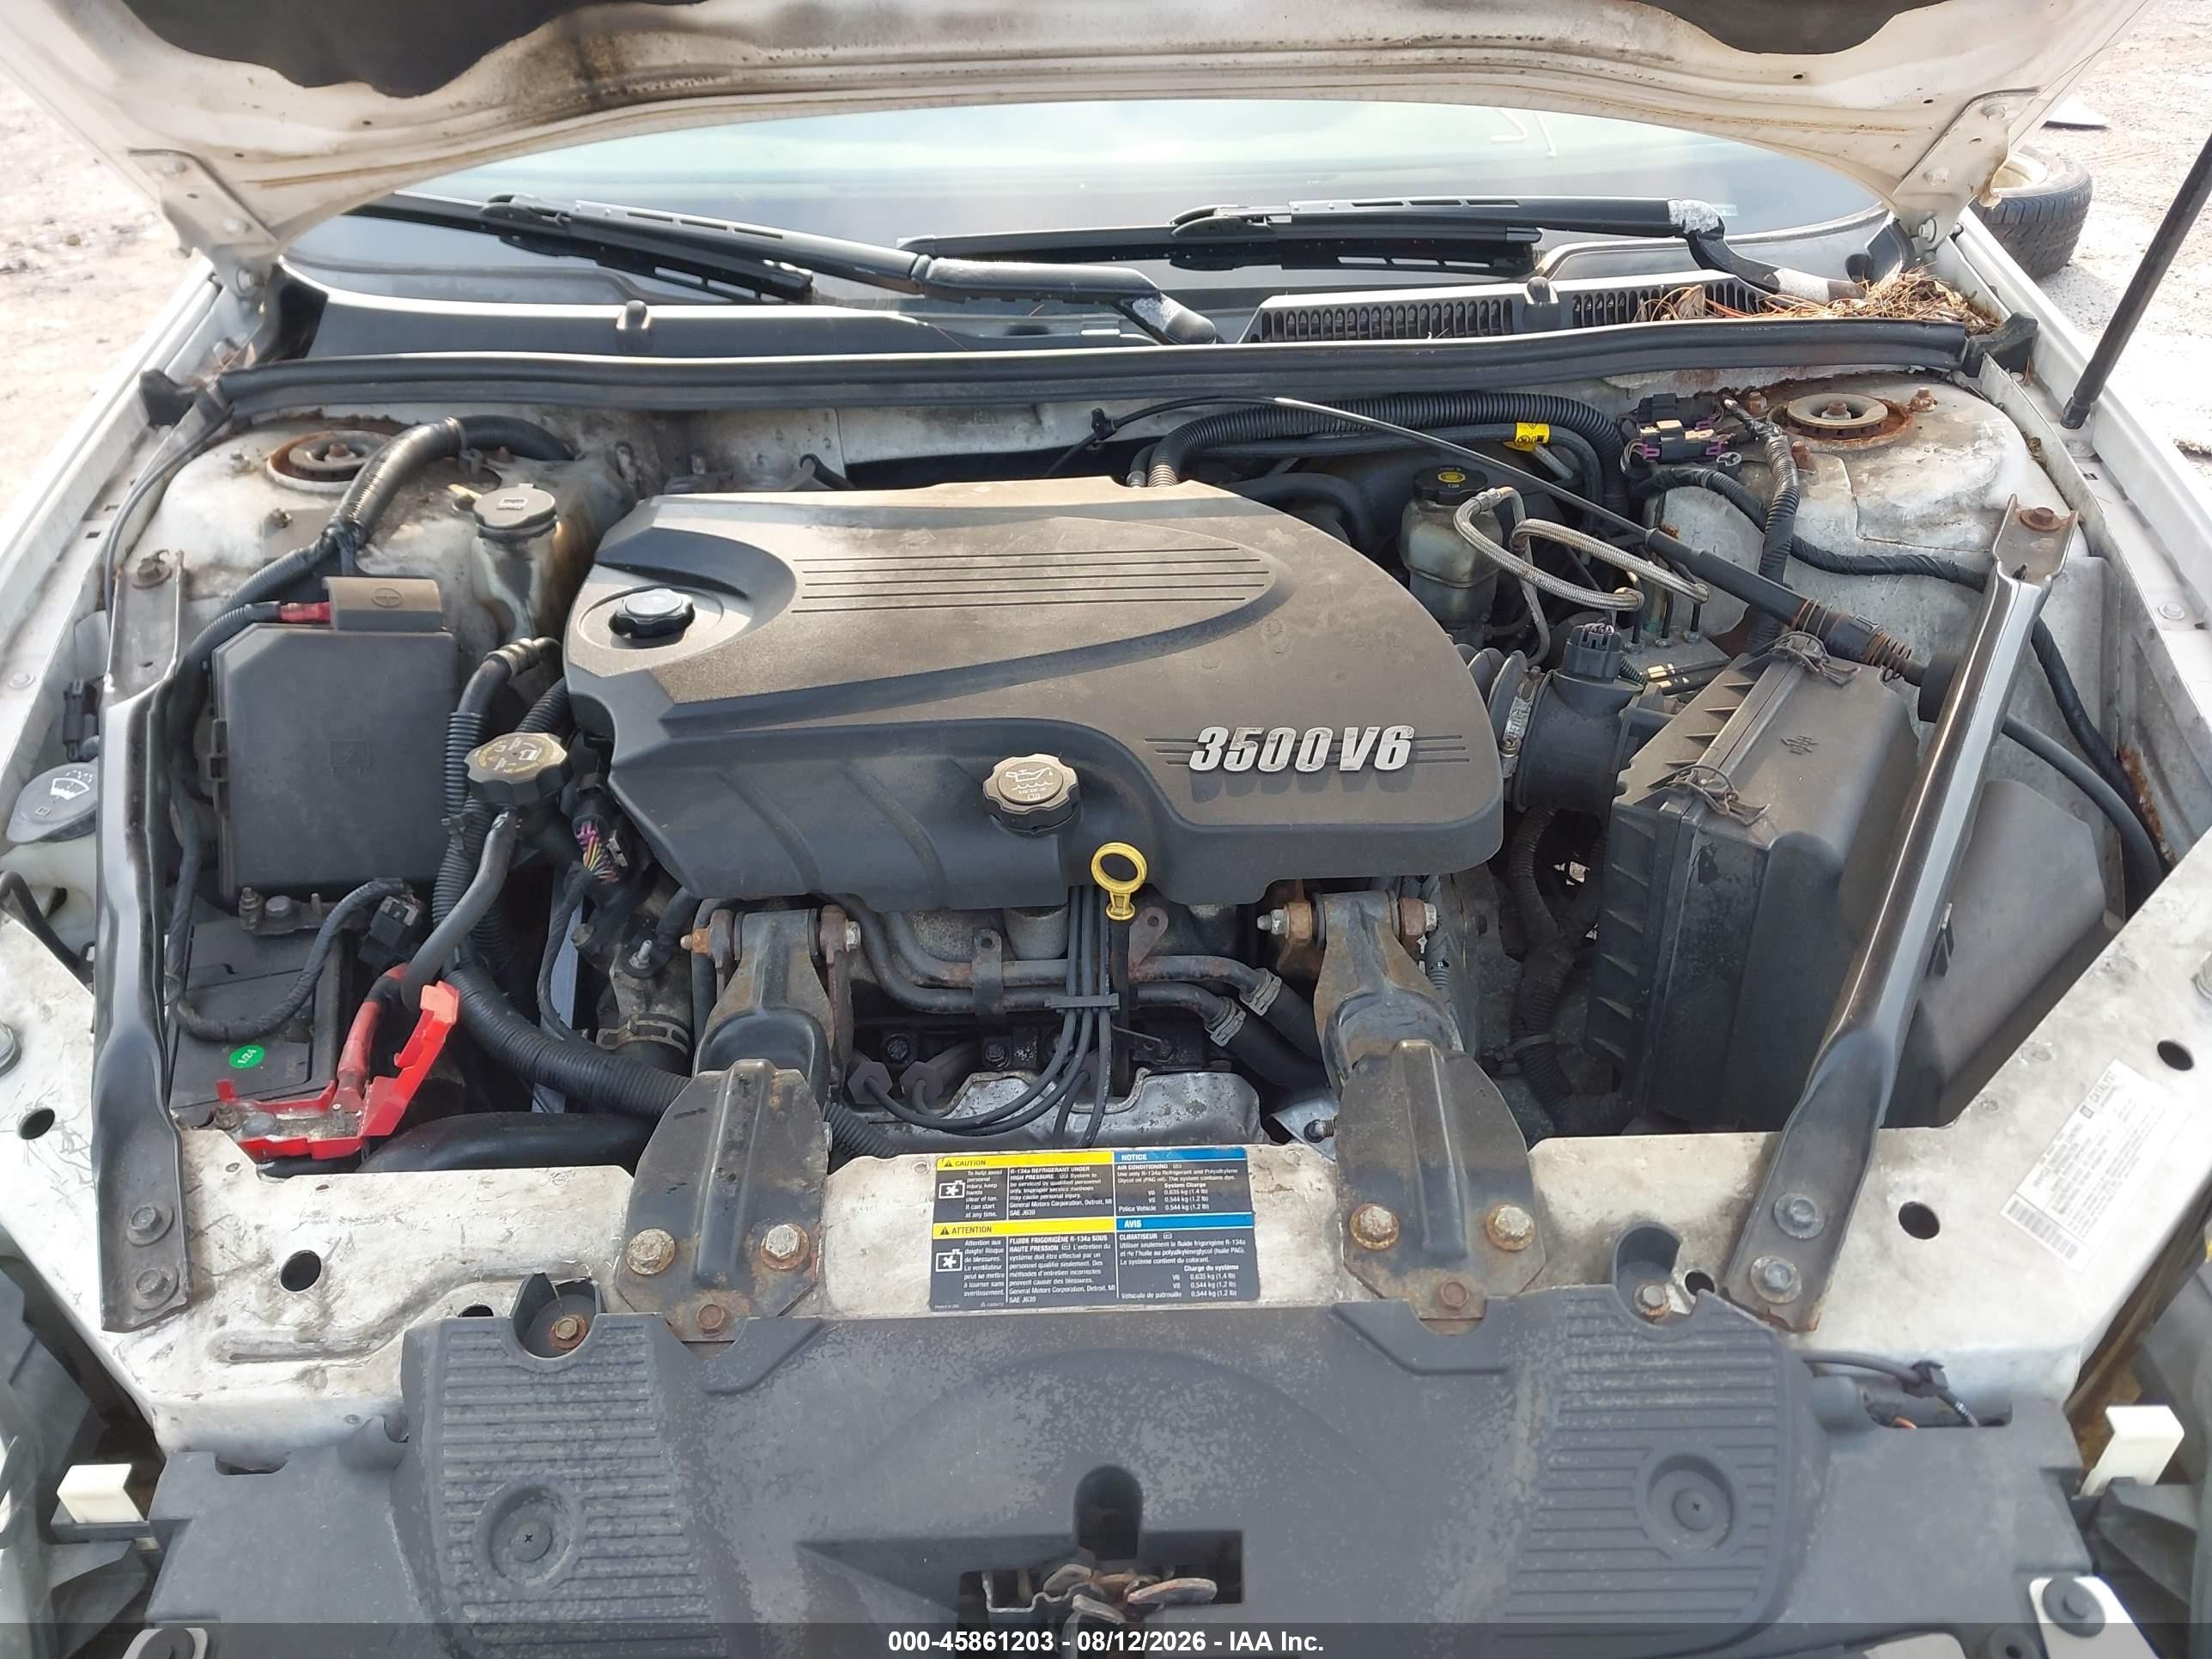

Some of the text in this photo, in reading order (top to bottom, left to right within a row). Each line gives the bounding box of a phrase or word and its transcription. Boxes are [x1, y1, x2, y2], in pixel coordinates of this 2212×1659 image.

[238, 1049, 257, 1064] 1/24
[2088, 1070, 2117, 1103] CATALYST
[1121, 1153, 1148, 1162] NOTICE
[1124, 1219, 1142, 1229] AVIS
[951, 1226, 992, 1235] ATTENTION
